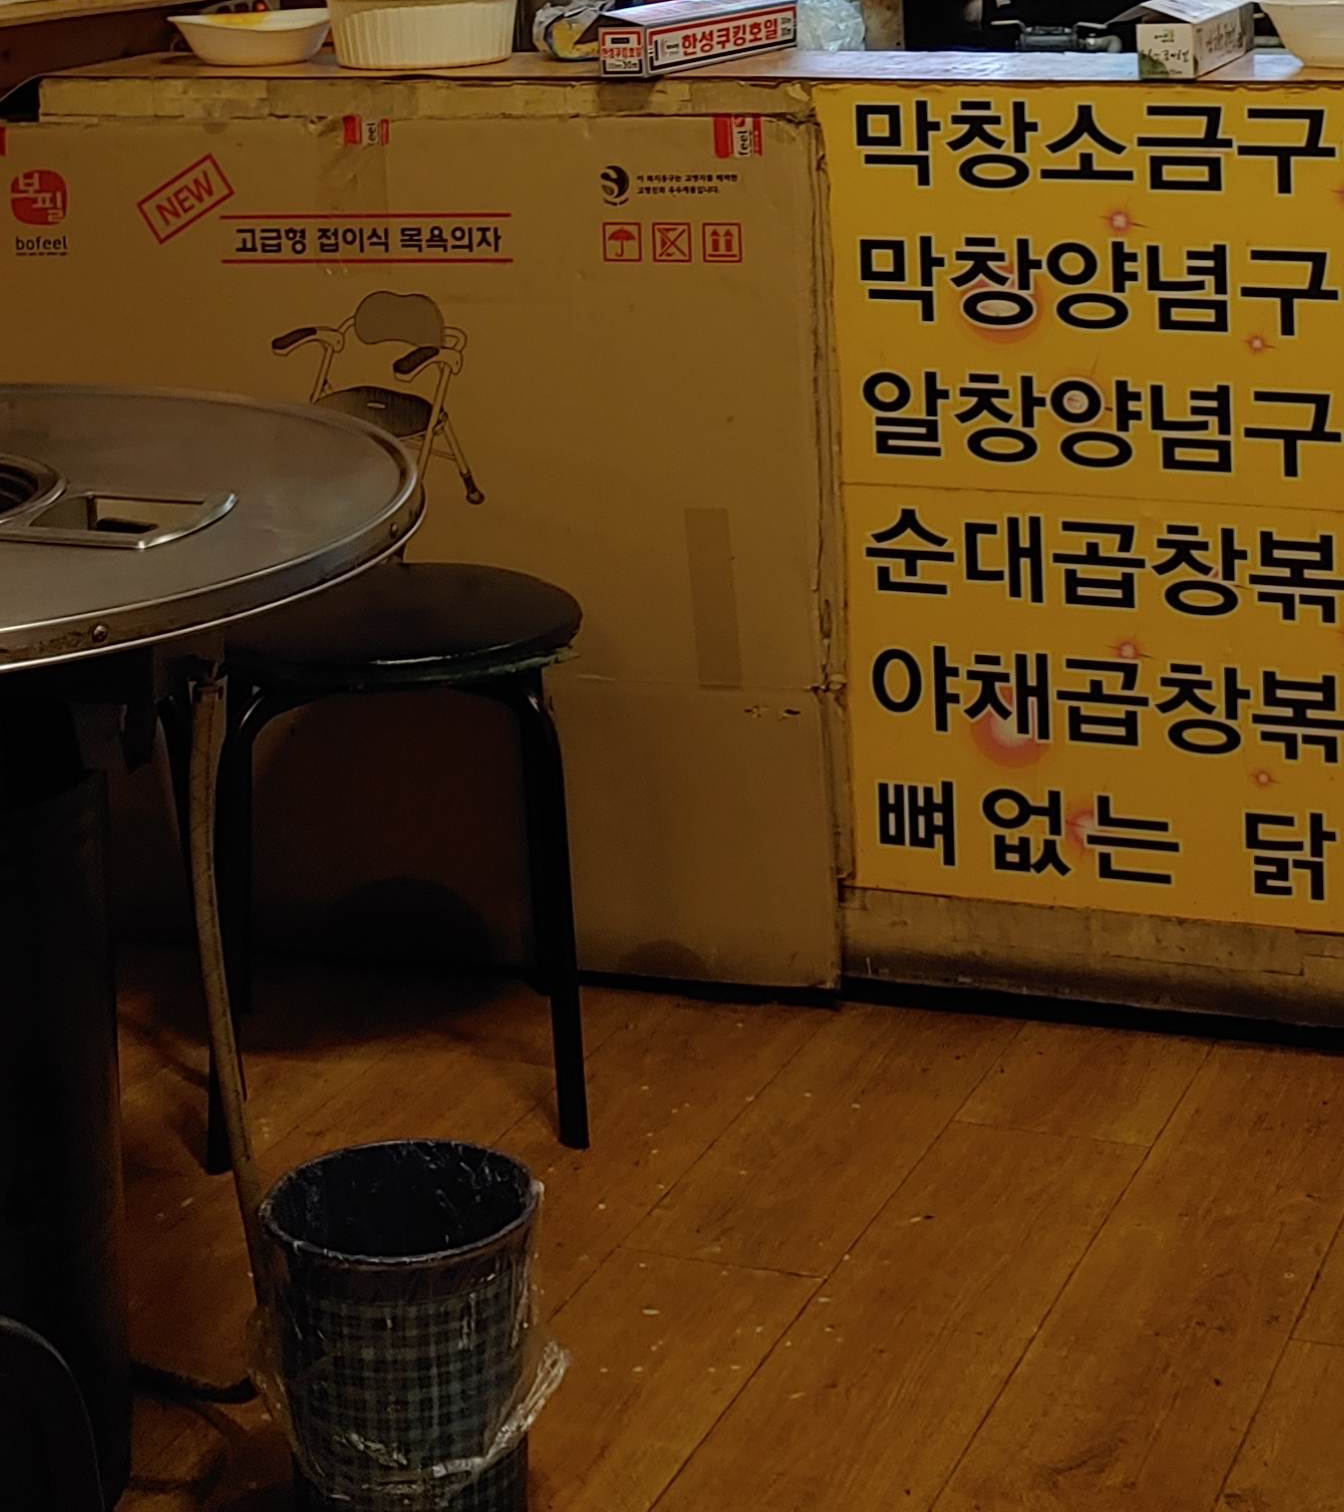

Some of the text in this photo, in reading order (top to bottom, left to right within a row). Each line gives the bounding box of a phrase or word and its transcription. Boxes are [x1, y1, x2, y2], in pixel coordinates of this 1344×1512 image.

[681, 18, 779, 57] 한성쿠킹호일
[155, 170, 215, 227] NEW
[15, 235, 68, 251] bofeel
[235, 226, 502, 255] 고급형 접이식 목욕의자
